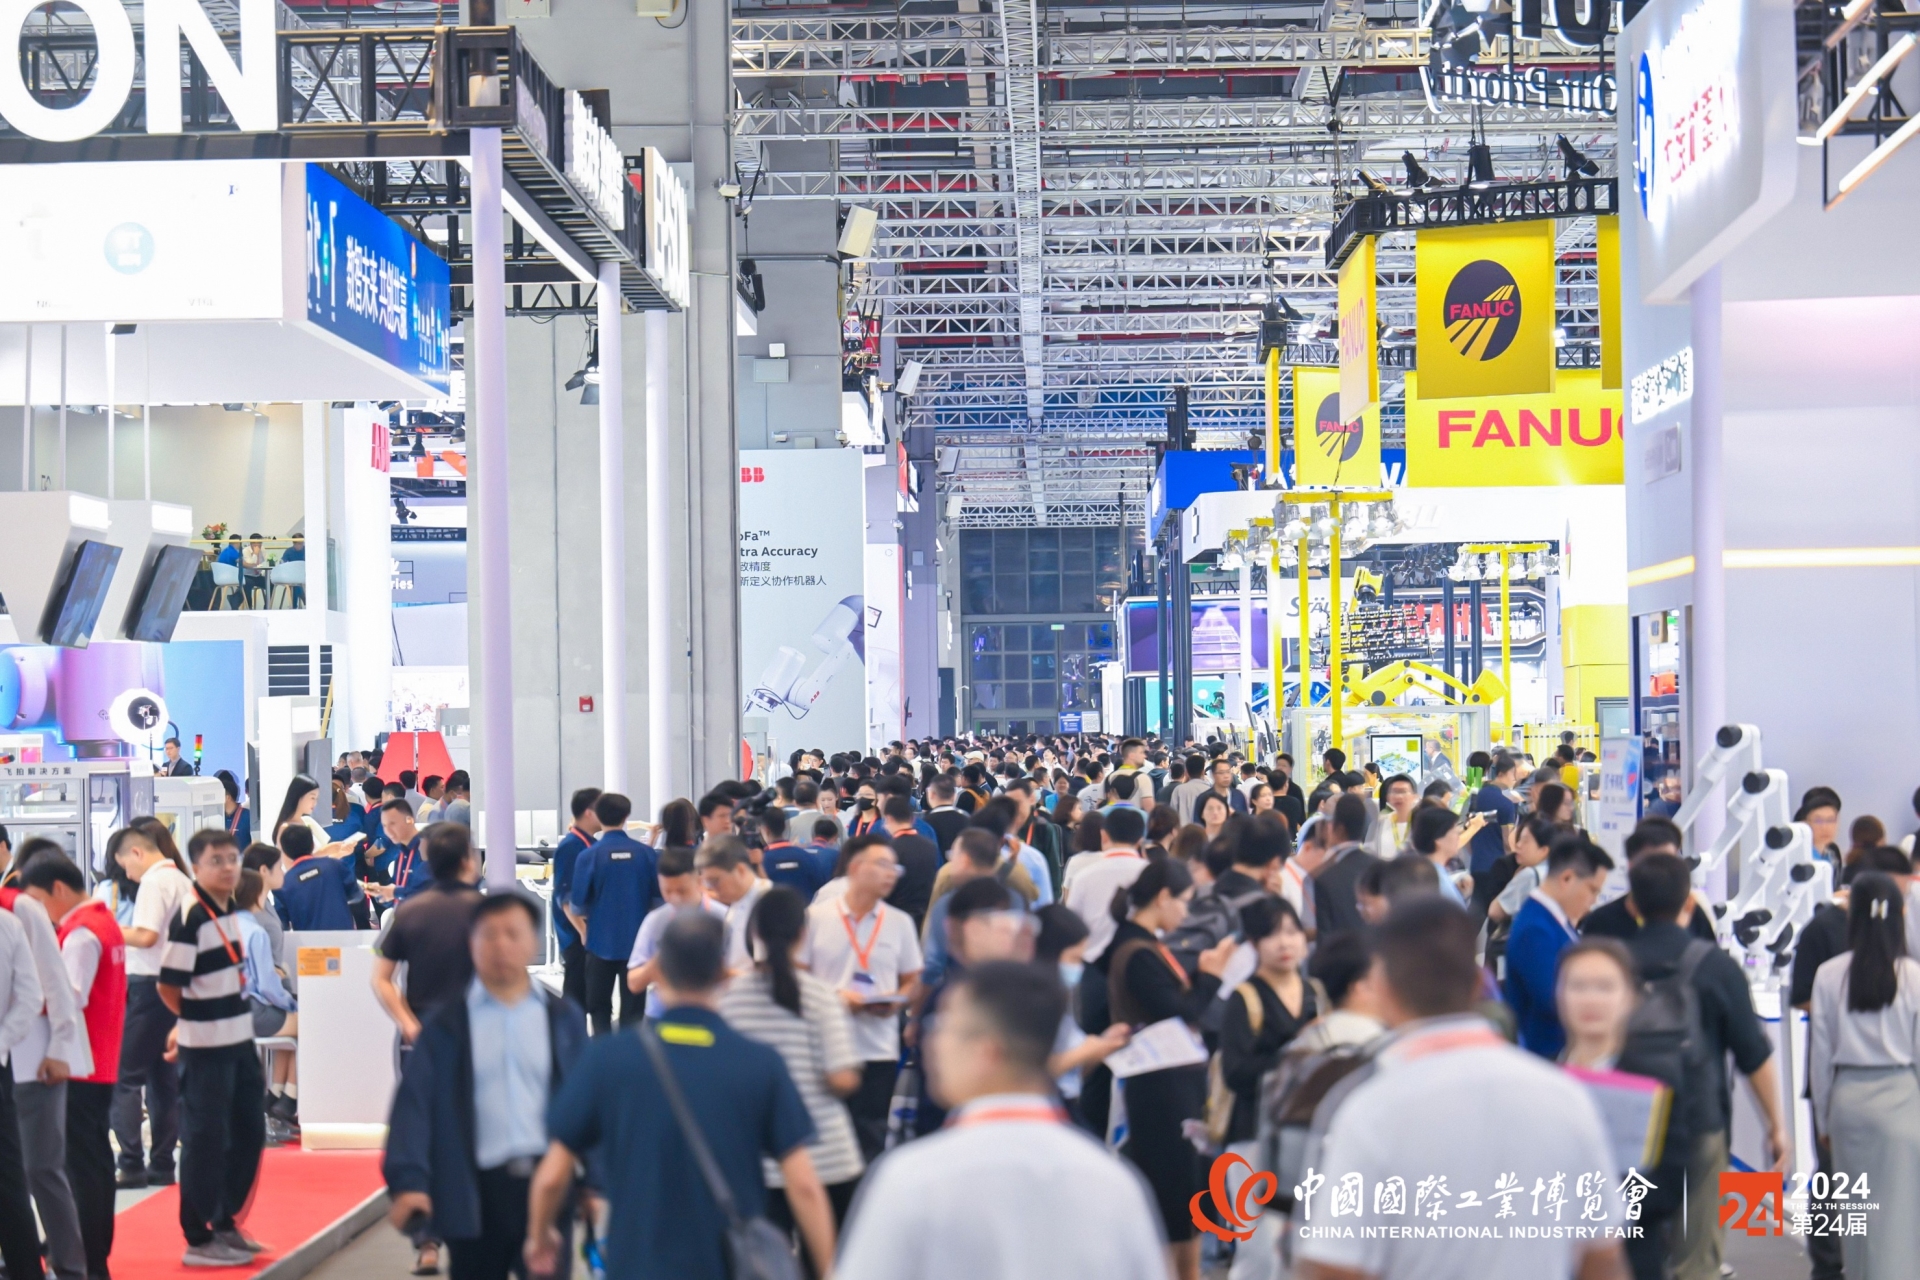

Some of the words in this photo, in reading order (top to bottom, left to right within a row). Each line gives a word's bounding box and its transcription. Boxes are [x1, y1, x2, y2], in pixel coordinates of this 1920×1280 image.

[1450, 300, 1514, 319] FANUC
[1438, 408, 1623, 448] FANU
[761, 547, 818, 558] Accuracy
